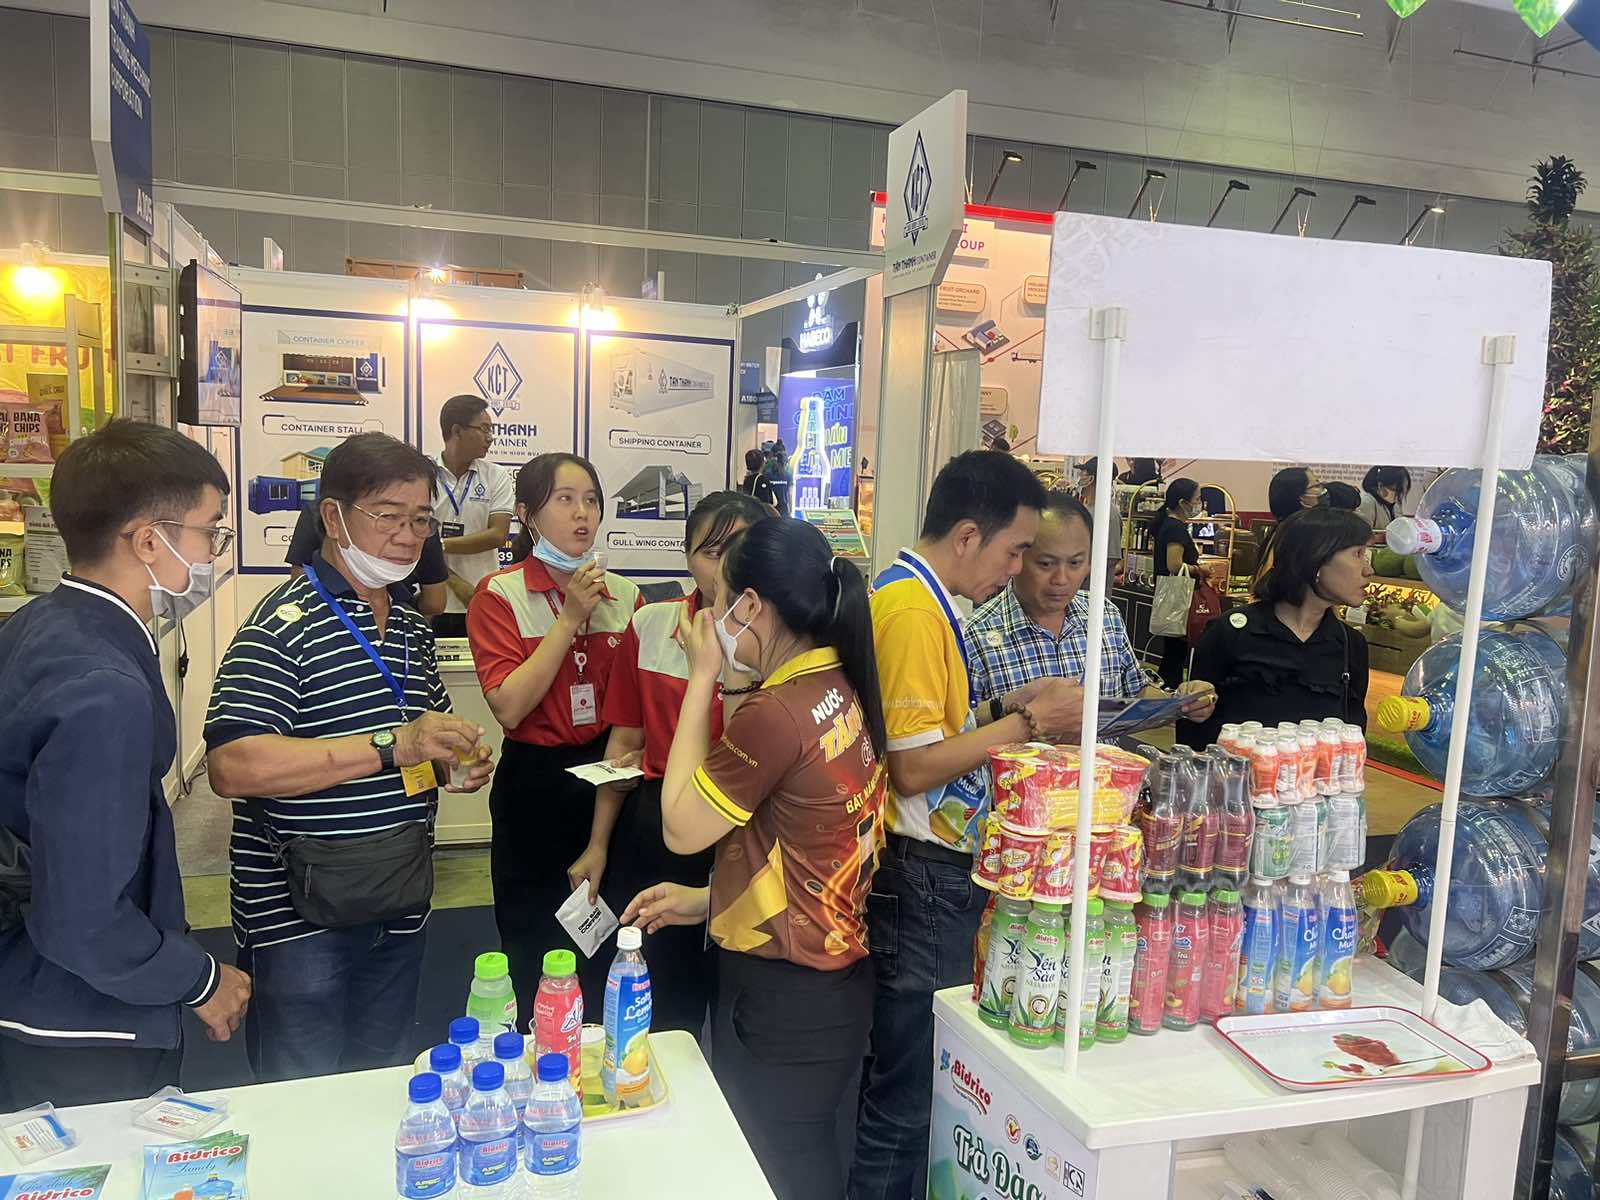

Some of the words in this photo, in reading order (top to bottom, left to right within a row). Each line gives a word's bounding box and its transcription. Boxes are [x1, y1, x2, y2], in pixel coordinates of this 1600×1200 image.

[959, 239, 985, 251] OUP
[487, 363, 509, 396] KCT
[13, 412, 41, 423] BANA
[14, 422, 41, 434] CHIPS
[281, 423, 335, 433] CONTAINER
[491, 423, 537, 437] THANH
[493, 438, 528, 448] TAINER
[618, 437, 656, 446] SHIPPING
[657, 439, 702, 448] CONTAINER
[658, 540, 686, 548] CONTA
[498, 551, 513, 562] 39
[811, 688, 844, 725] NƯỚC
[580, 910, 602, 934] COFFEE
[953, 1060, 993, 1106] Bidrico
[166, 1145, 242, 1164] Bidrico
[953, 1124, 990, 1185] Trà
[15, 1187, 94, 1200] Bidrico
